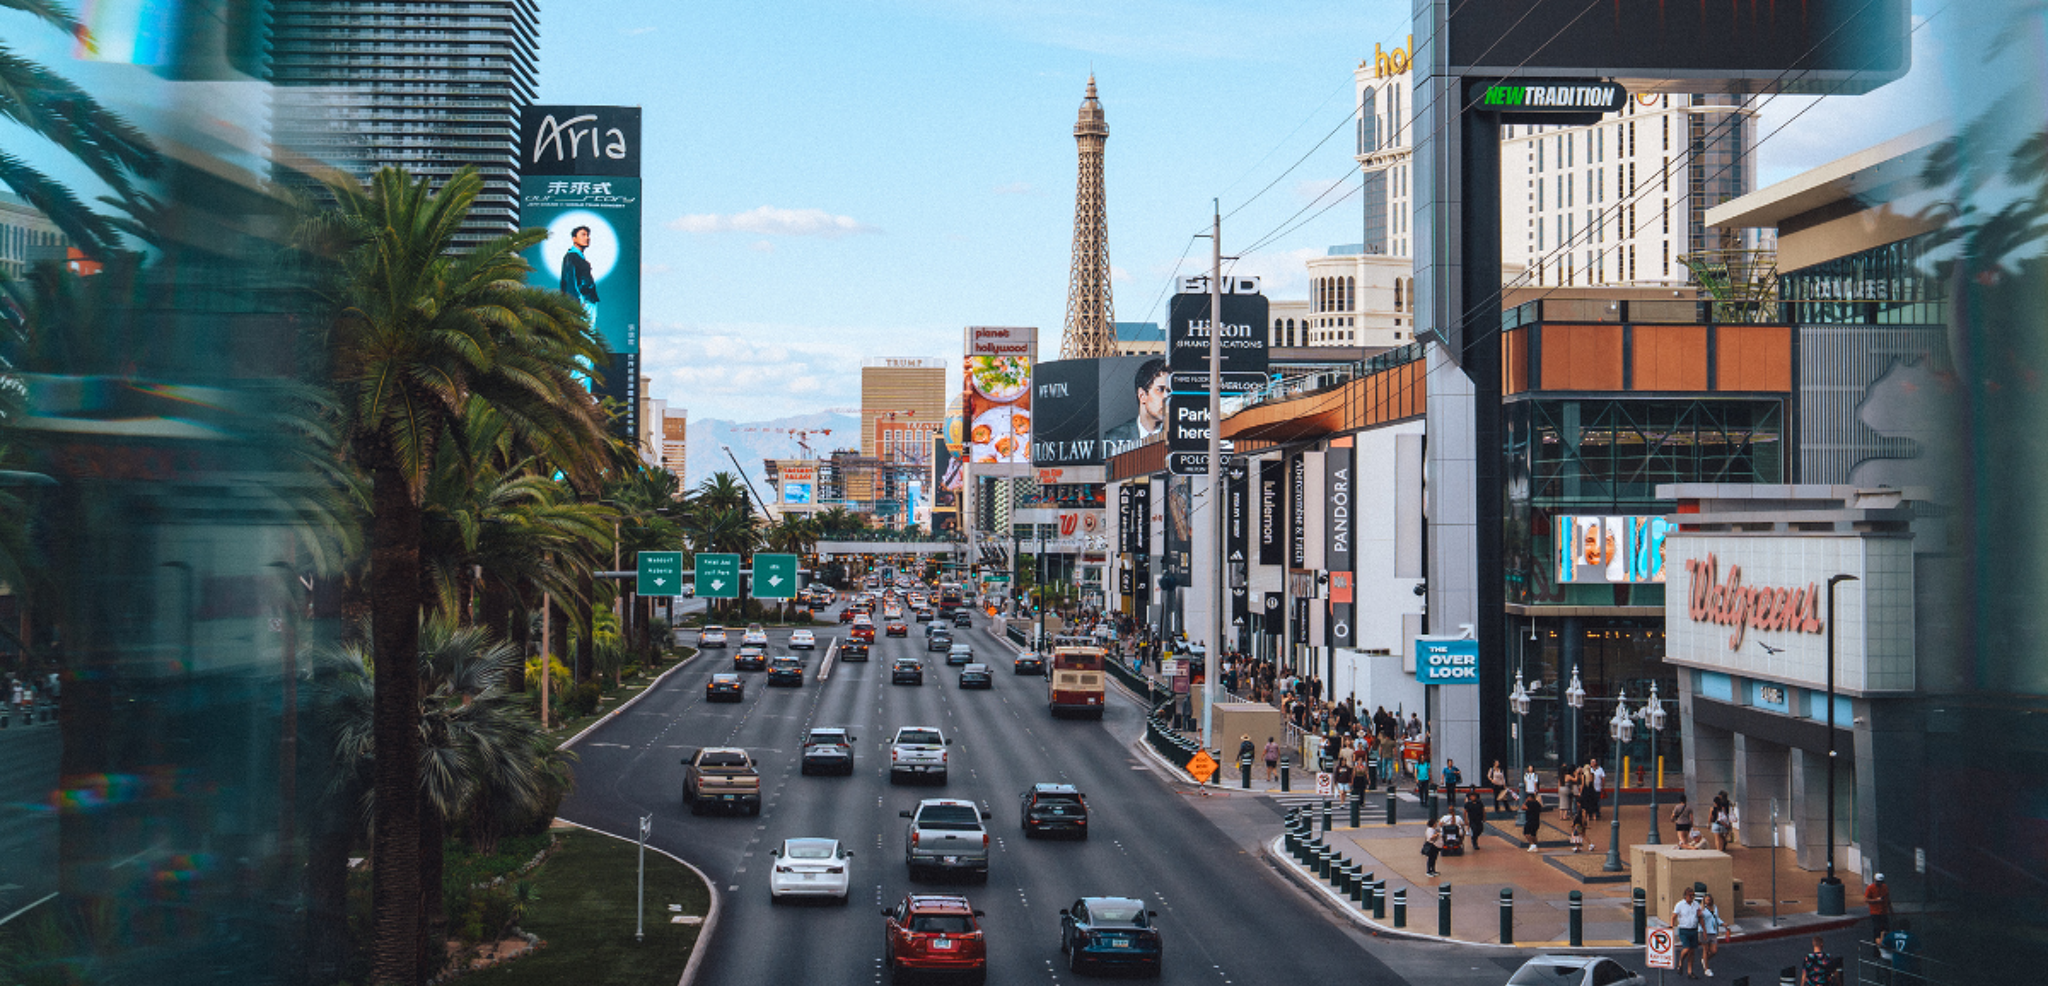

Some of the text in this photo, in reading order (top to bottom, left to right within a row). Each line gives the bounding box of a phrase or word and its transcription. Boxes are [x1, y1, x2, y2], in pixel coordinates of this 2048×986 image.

[1484, 86, 1616, 107] NEWTRADITION
[533, 114, 627, 163] Aria
[547, 181, 612, 195] 未來式
[976, 327, 1010, 340] planet
[1187, 319, 1252, 338] Hiton
[976, 342, 1028, 354] hollywood
[1218, 341, 1263, 349] ACATIONS
[886, 359, 922, 367] TRUMP
[1220, 382, 1265, 390] VERLOOK
[1178, 407, 1211, 421] Park
[1178, 426, 1212, 439] here
[1059, 440, 1094, 461] LAW
[1263, 480, 1276, 544] lululemon
[1334, 467, 1348, 552] PANDORA
[1685, 551, 1824, 651] Walgreens
[1429, 655, 1476, 665] OVER
[1429, 667, 1476, 678] LOOK
